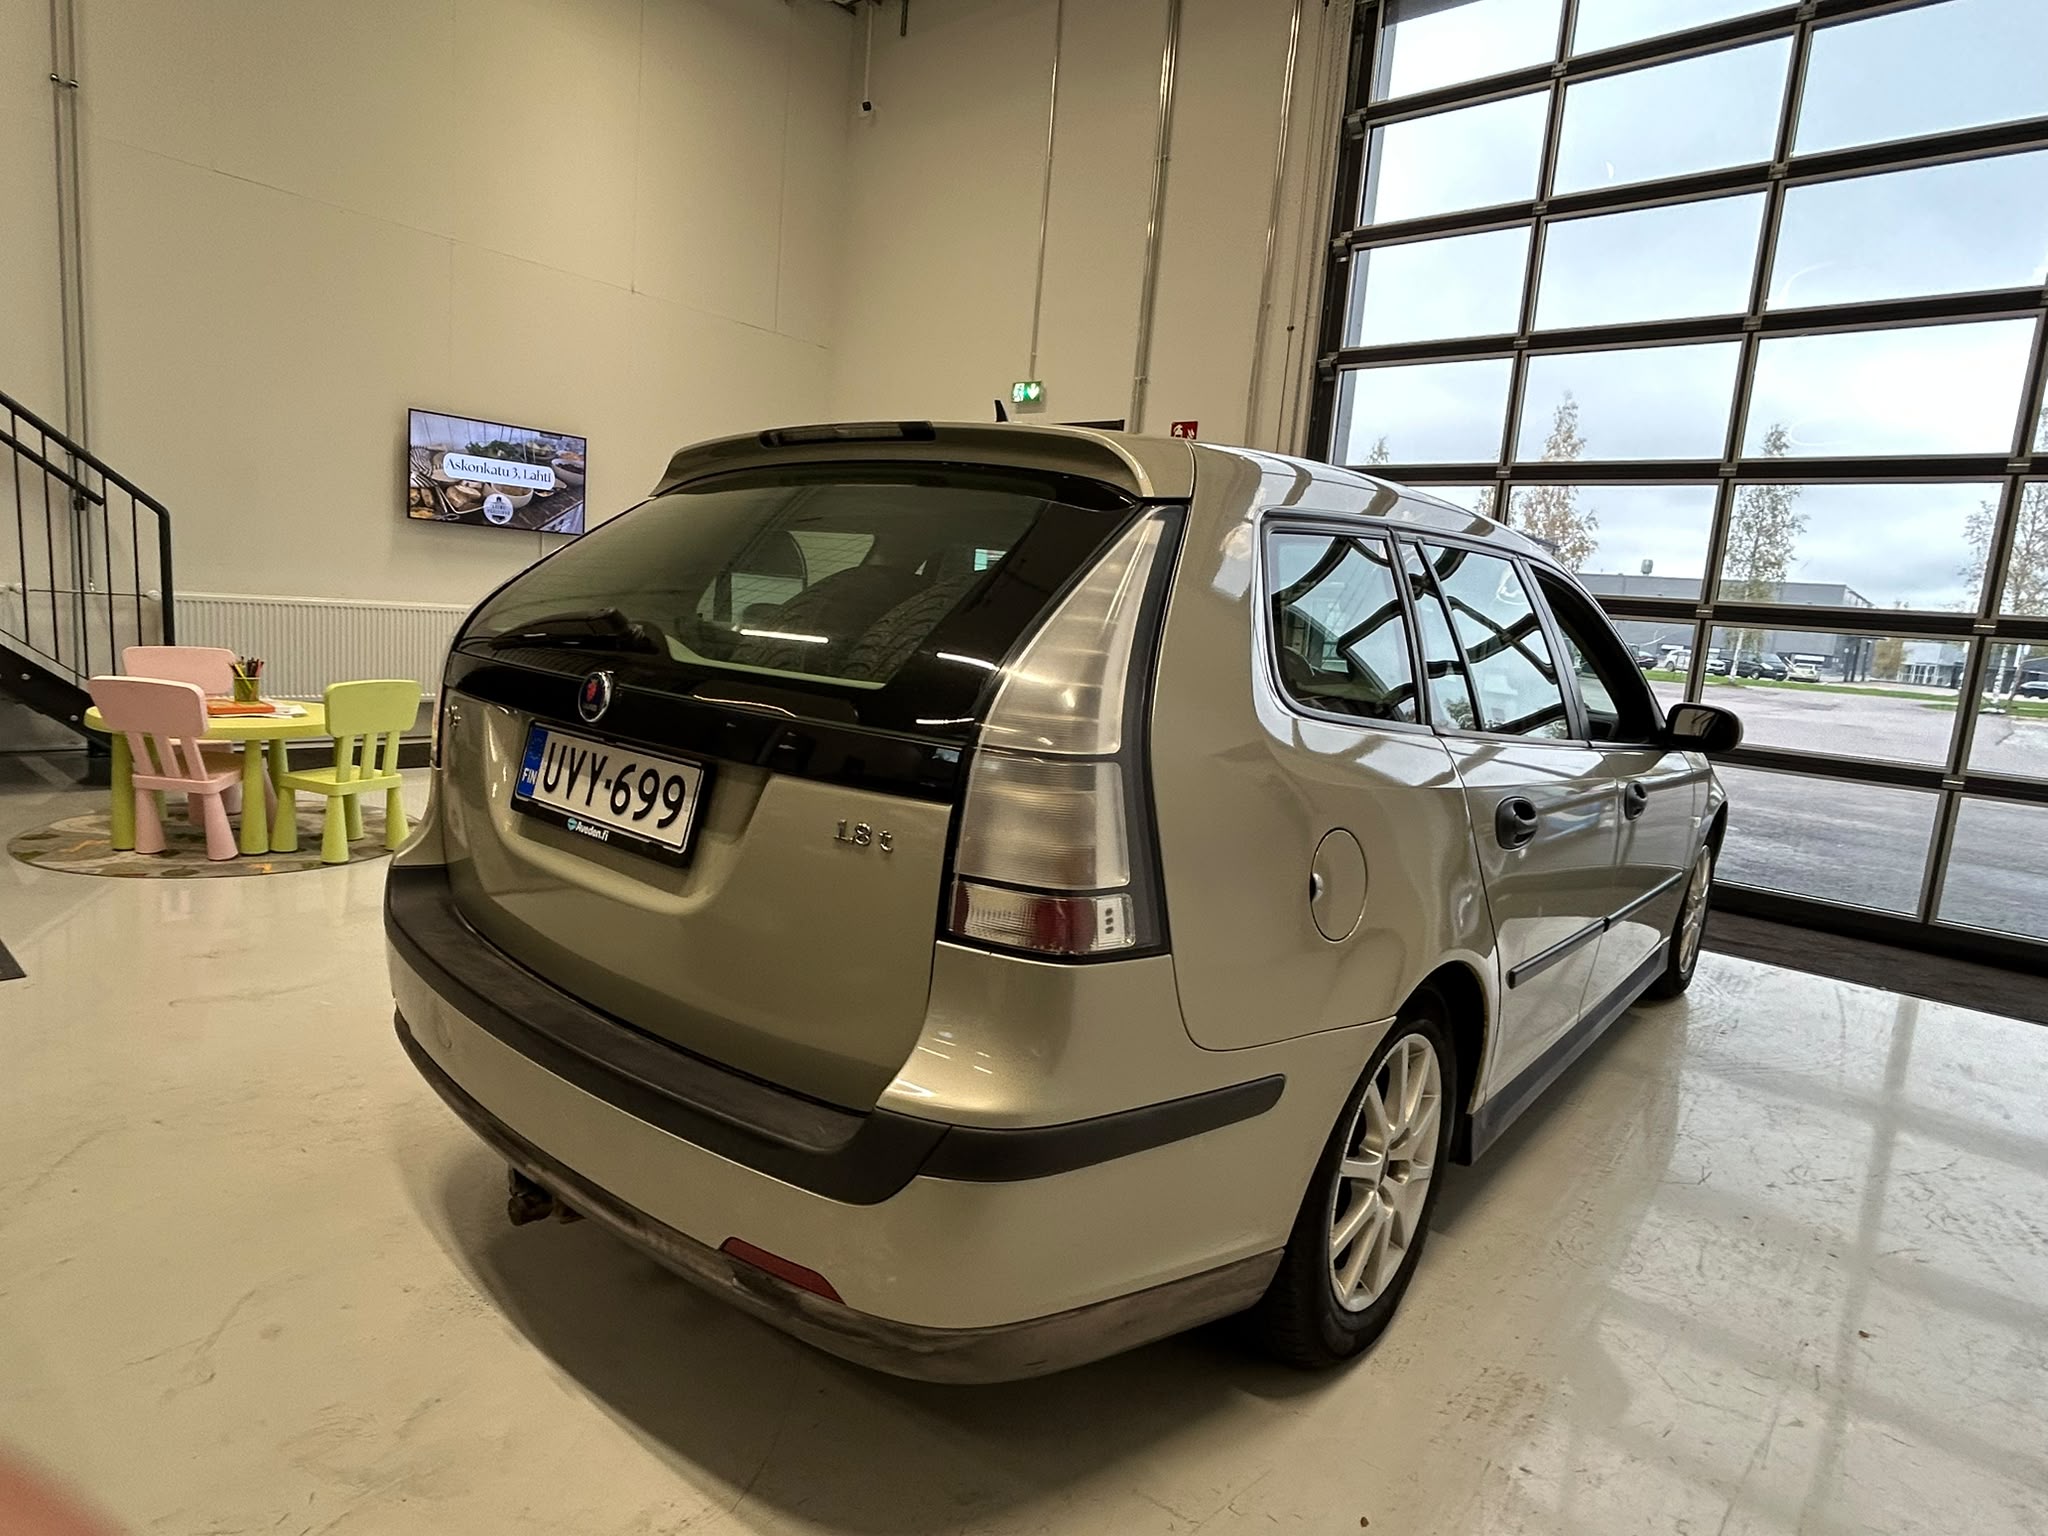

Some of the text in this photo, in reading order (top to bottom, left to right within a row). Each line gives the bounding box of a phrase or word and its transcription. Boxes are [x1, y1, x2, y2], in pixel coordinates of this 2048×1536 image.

[446, 458, 509, 477] Askonkatu
[523, 469, 552, 483] Lahti
[521, 767, 538, 785] FIN
[543, 742, 686, 829] UVY-699
